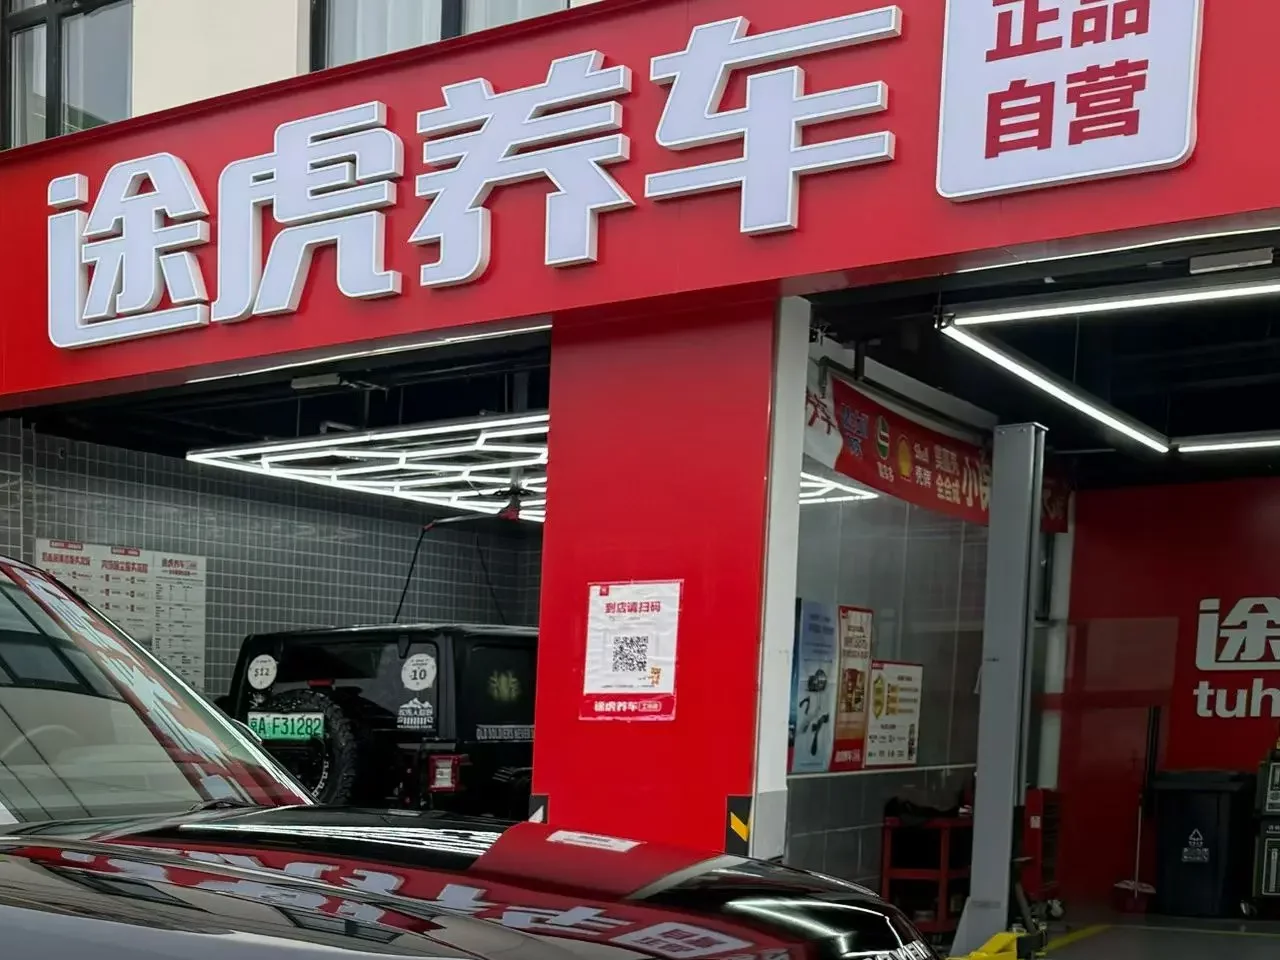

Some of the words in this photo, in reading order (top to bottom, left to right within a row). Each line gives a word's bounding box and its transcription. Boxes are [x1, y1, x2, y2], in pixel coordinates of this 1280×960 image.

[985, 0, 1151, 62] 正品
[984, 59, 1150, 160] 自营
[47, 5, 902, 348] 途虎养车
[605, 601, 662, 613] 到店请扫码
